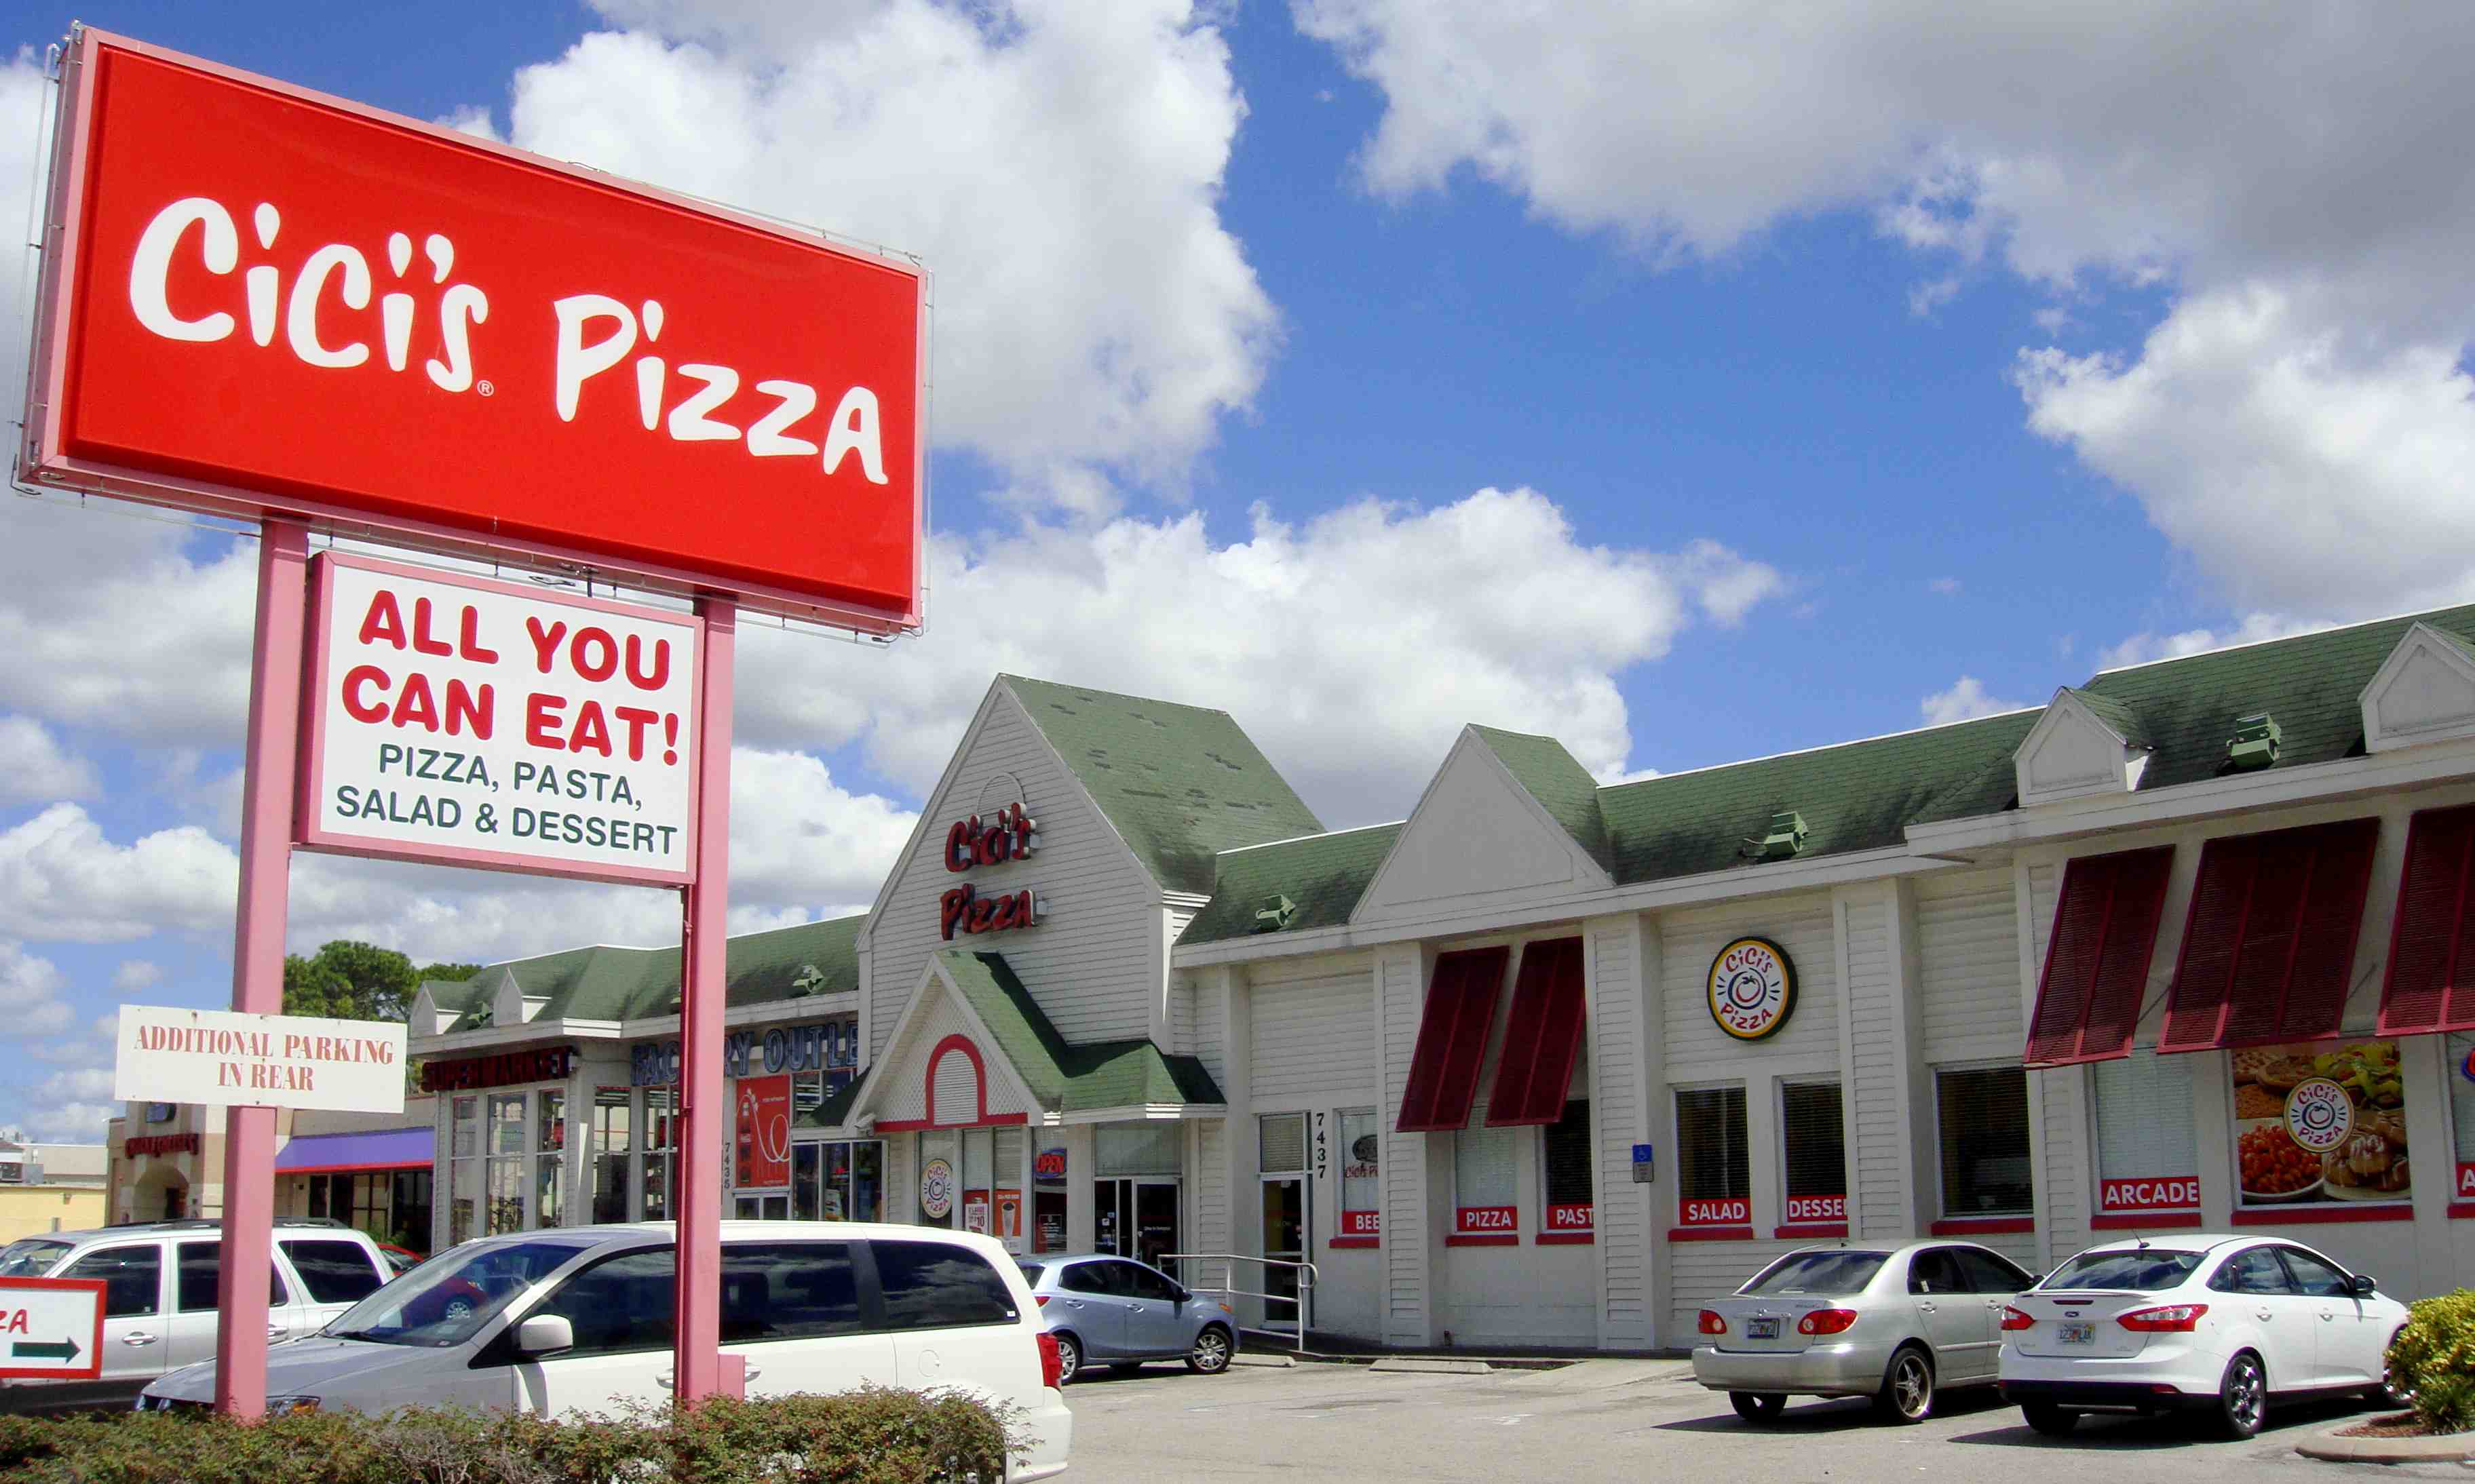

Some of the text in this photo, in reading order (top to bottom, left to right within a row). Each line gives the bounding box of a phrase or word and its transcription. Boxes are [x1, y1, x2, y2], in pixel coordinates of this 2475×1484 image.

[359, 589, 670, 692] ALL YOU
[342, 665, 679, 766] CAN EAT!
[379, 743, 642, 811] PIZZA, PASTA,
[337, 785, 678, 856] SALAD & DESSERT
[134, 1025, 394, 1066] ADDITIONAL PARKING
[763, 1020, 858, 1074] OUTLE
[217, 1062, 315, 1092] IN REAR
[1316, 1113, 1326, 1179] 7437
[1036, 1154, 1064, 1173] OPEN
[1789, 1198, 1847, 1217] DESSE
[2105, 1182, 2198, 1205] ARCADE
[1356, 1215, 1379, 1230] BEE
[1466, 1211, 1512, 1228] PIZZA
[1557, 1208, 1596, 1225] PAST
[1688, 1203, 1746, 1222] SALAD
